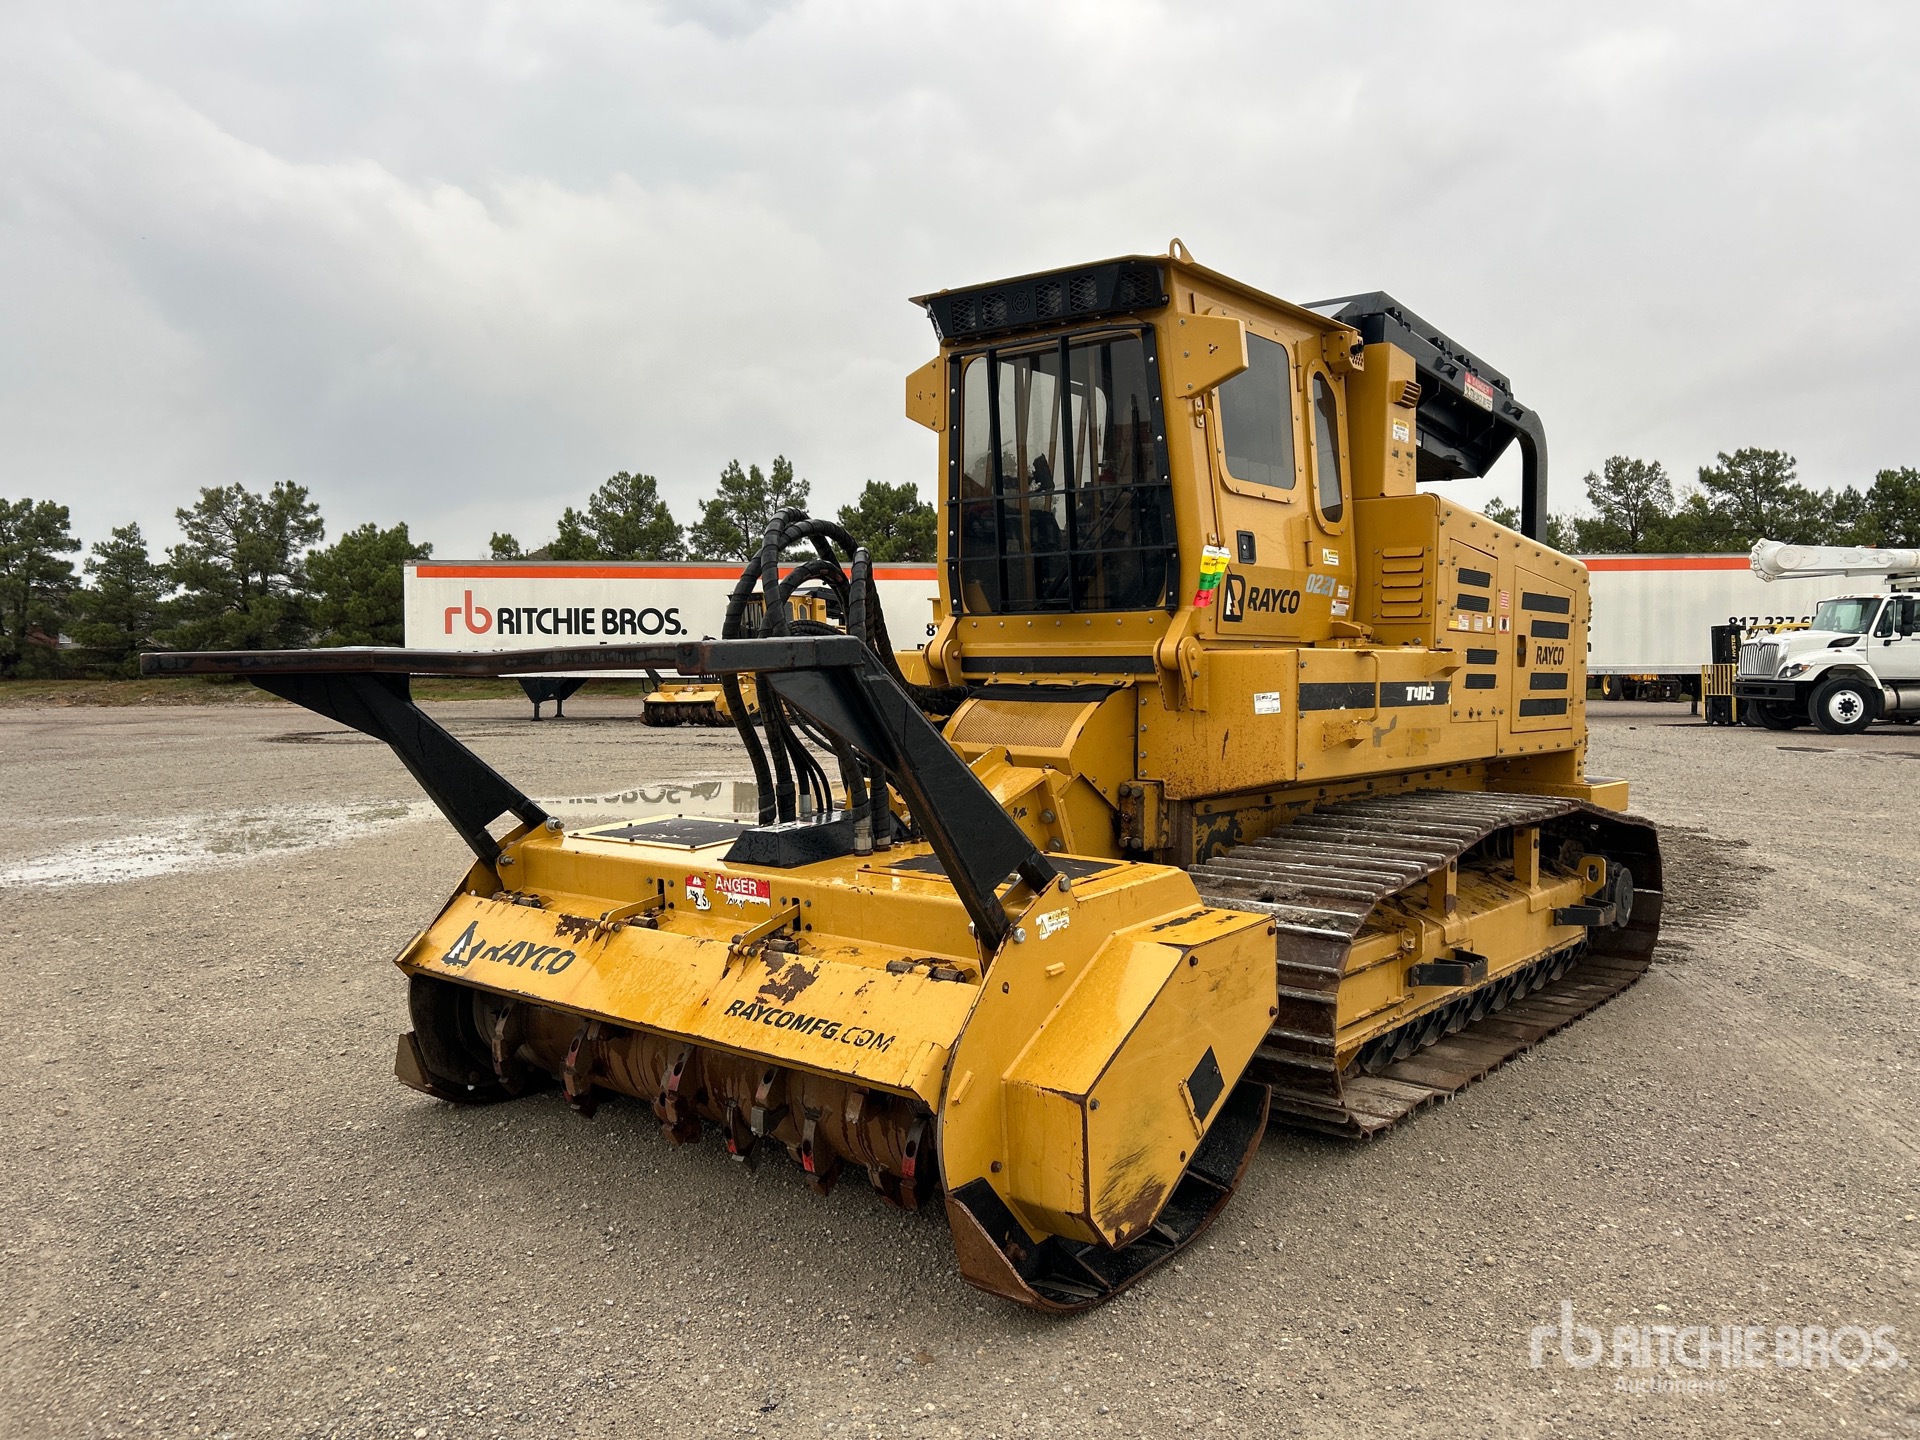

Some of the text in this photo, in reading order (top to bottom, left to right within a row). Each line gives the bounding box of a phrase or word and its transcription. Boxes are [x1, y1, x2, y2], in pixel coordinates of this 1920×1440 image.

[1305, 574, 1336, 597] 0221
[1247, 586, 1301, 615] RAYCO
[497, 608, 595, 635] RITCHIE
[602, 608, 688, 635] BROS.
[1535, 646, 1565, 666] RAYCO
[1405, 686, 1435, 702] T415
[715, 876, 757, 895] ANGER
[724, 999, 897, 1053] RAYCOMFG.COM
